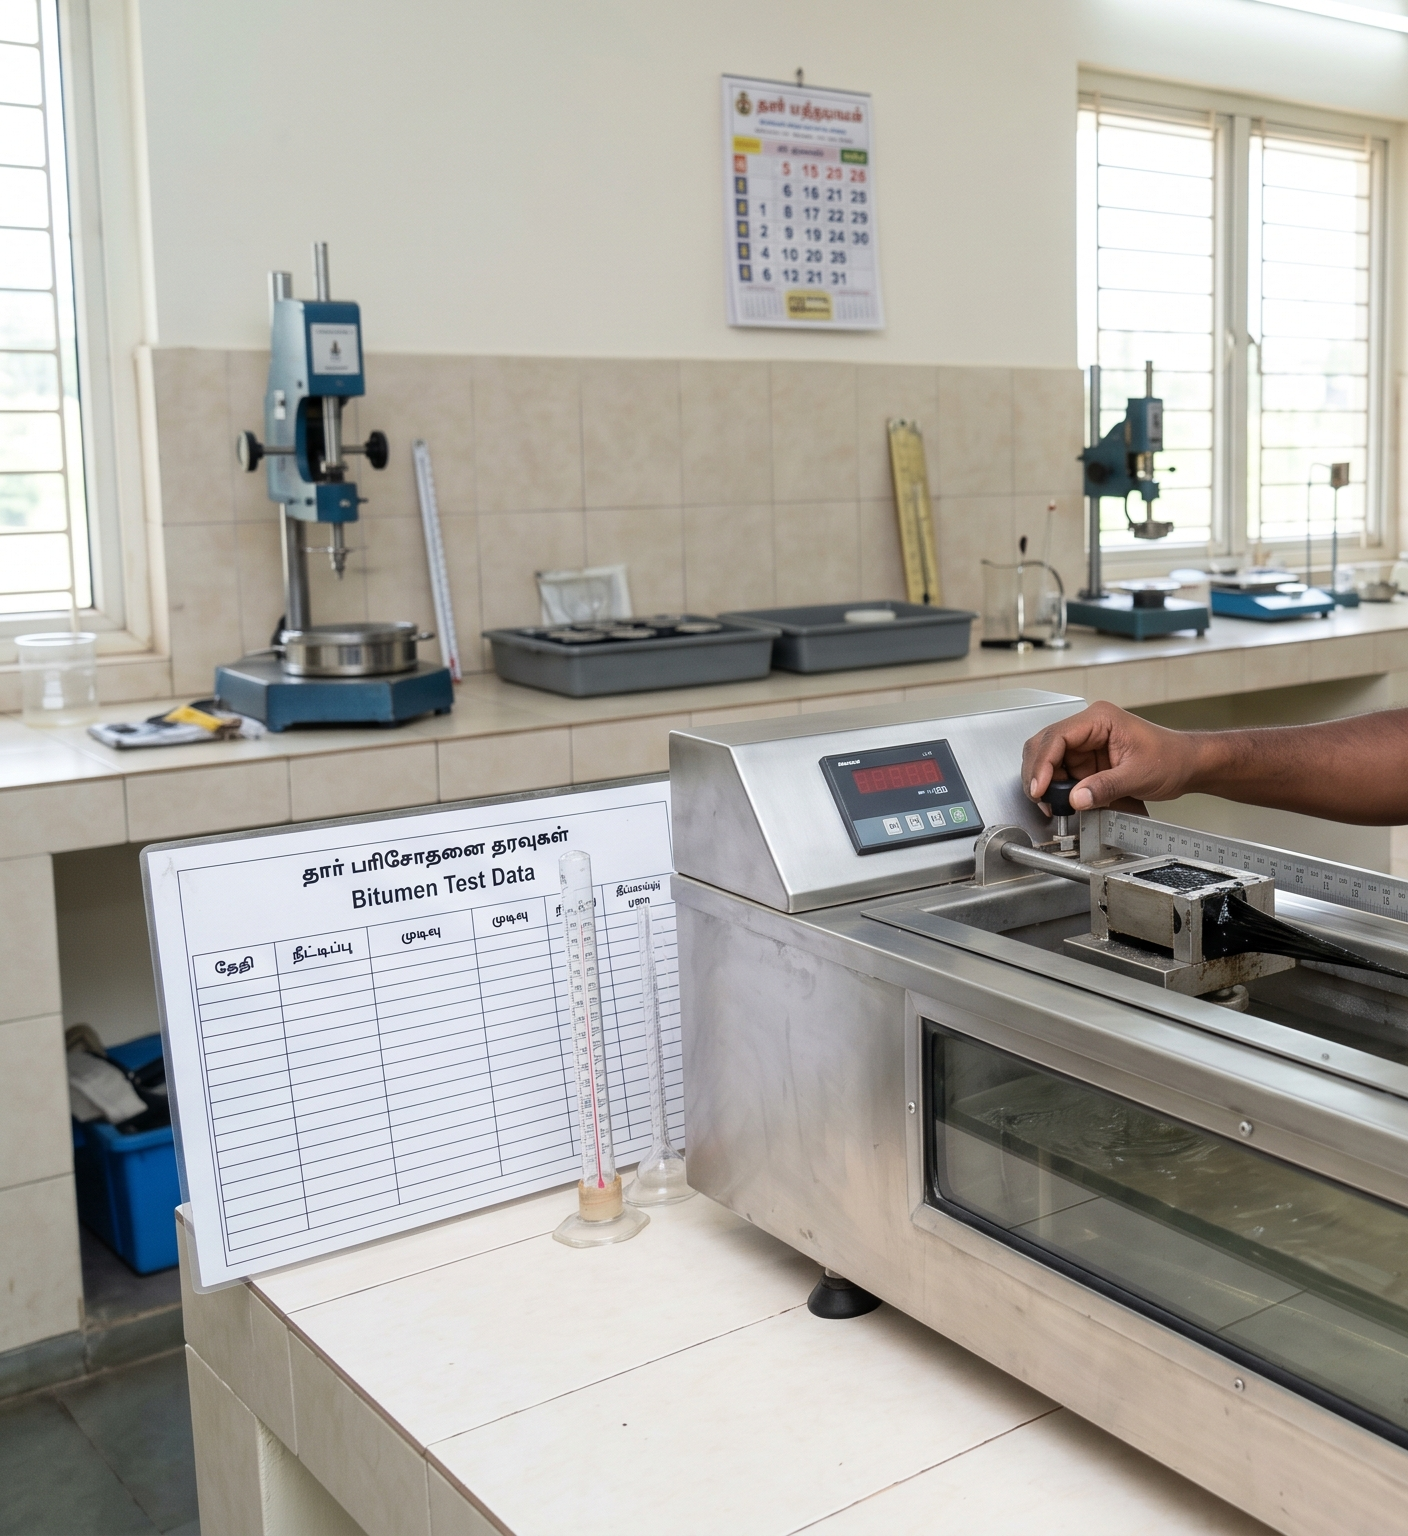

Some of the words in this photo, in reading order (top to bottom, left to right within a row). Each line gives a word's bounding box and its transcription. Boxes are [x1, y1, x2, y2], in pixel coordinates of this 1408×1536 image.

[783, 183, 792, 198] 6
[804, 186, 819, 200] 16
[827, 188, 842, 201] 21
[805, 207, 820, 220] 17
[828, 209, 844, 222] 22
[852, 211, 868, 224] 29
[761, 225, 768, 238] 2
[785, 226, 793, 240] 9
[806, 228, 822, 241] 19
[829, 230, 845, 243] 24
[853, 231, 869, 245] 30
[762, 246, 770, 259] 4
[782, 248, 798, 261] 10
[806, 249, 822, 262] 20
[763, 268, 771, 281] 6
[784, 269, 799, 282] 12
[807, 270, 822, 283] 21
[302, 858, 345, 887] தார்
[351, 842, 486, 874] பரிசோதனை
[492, 826, 569, 858] தரவுகள்
[351, 879, 438, 909] Bitumen
[444, 871, 487, 895] Test
[492, 864, 536, 887] Data
[292, 941, 353, 965] நீட்டிப்பு
[214, 955, 255, 977] தேதி
